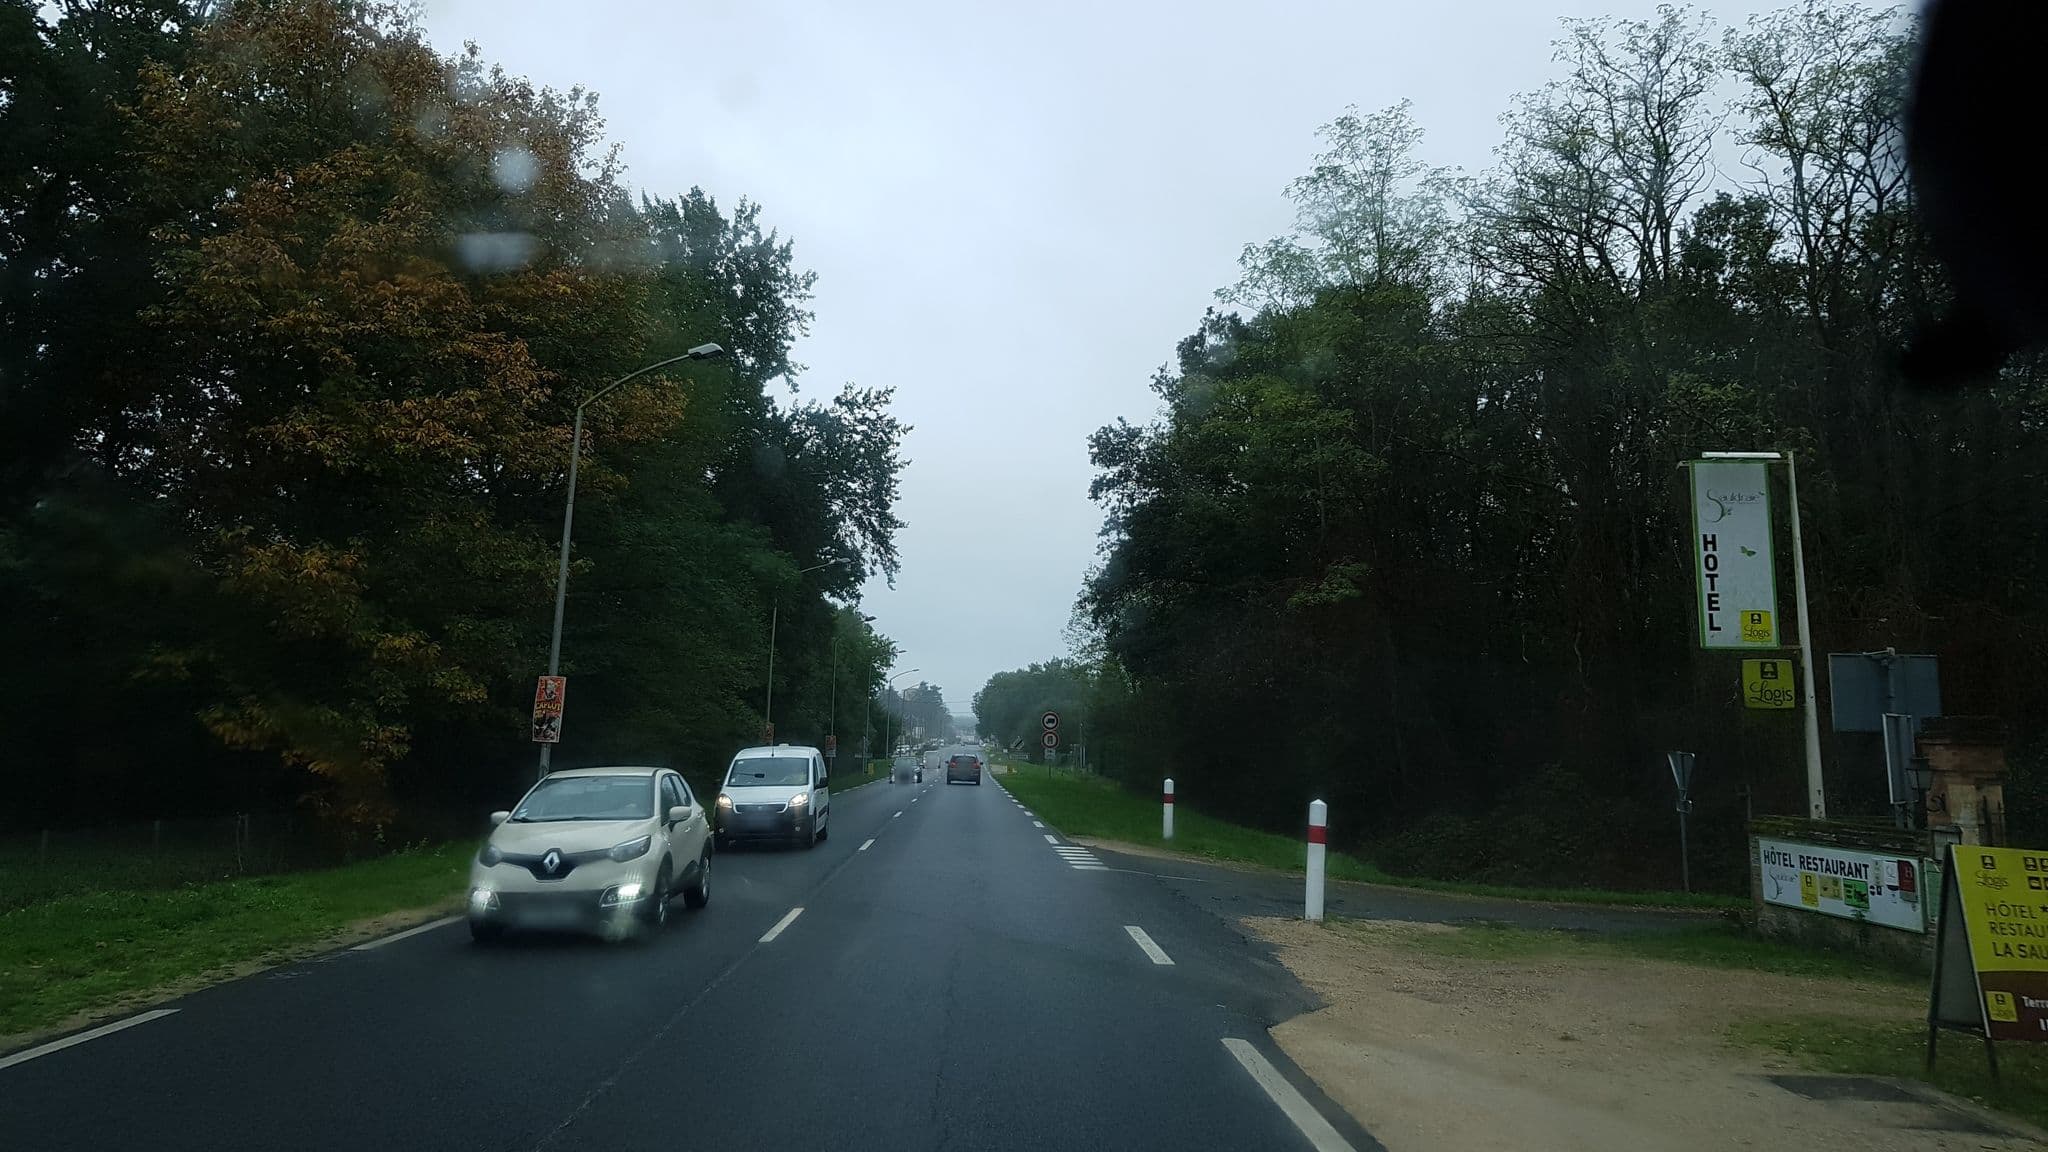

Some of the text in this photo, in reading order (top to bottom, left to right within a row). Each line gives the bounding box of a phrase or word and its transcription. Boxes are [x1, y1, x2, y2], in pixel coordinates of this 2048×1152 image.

[1702, 533, 1722, 632] HOTEL
[1744, 624, 1770, 640] Logis
[1749, 680, 1793, 707] Logis
[1763, 846, 1869, 880] HÔTEL RESTAURANT
[1984, 900, 2038, 919] HÔTEL
[1988, 921, 2048, 938] RESTAU
[1992, 941, 2016, 958] LA
[2021, 995, 2048, 1009] Terr
